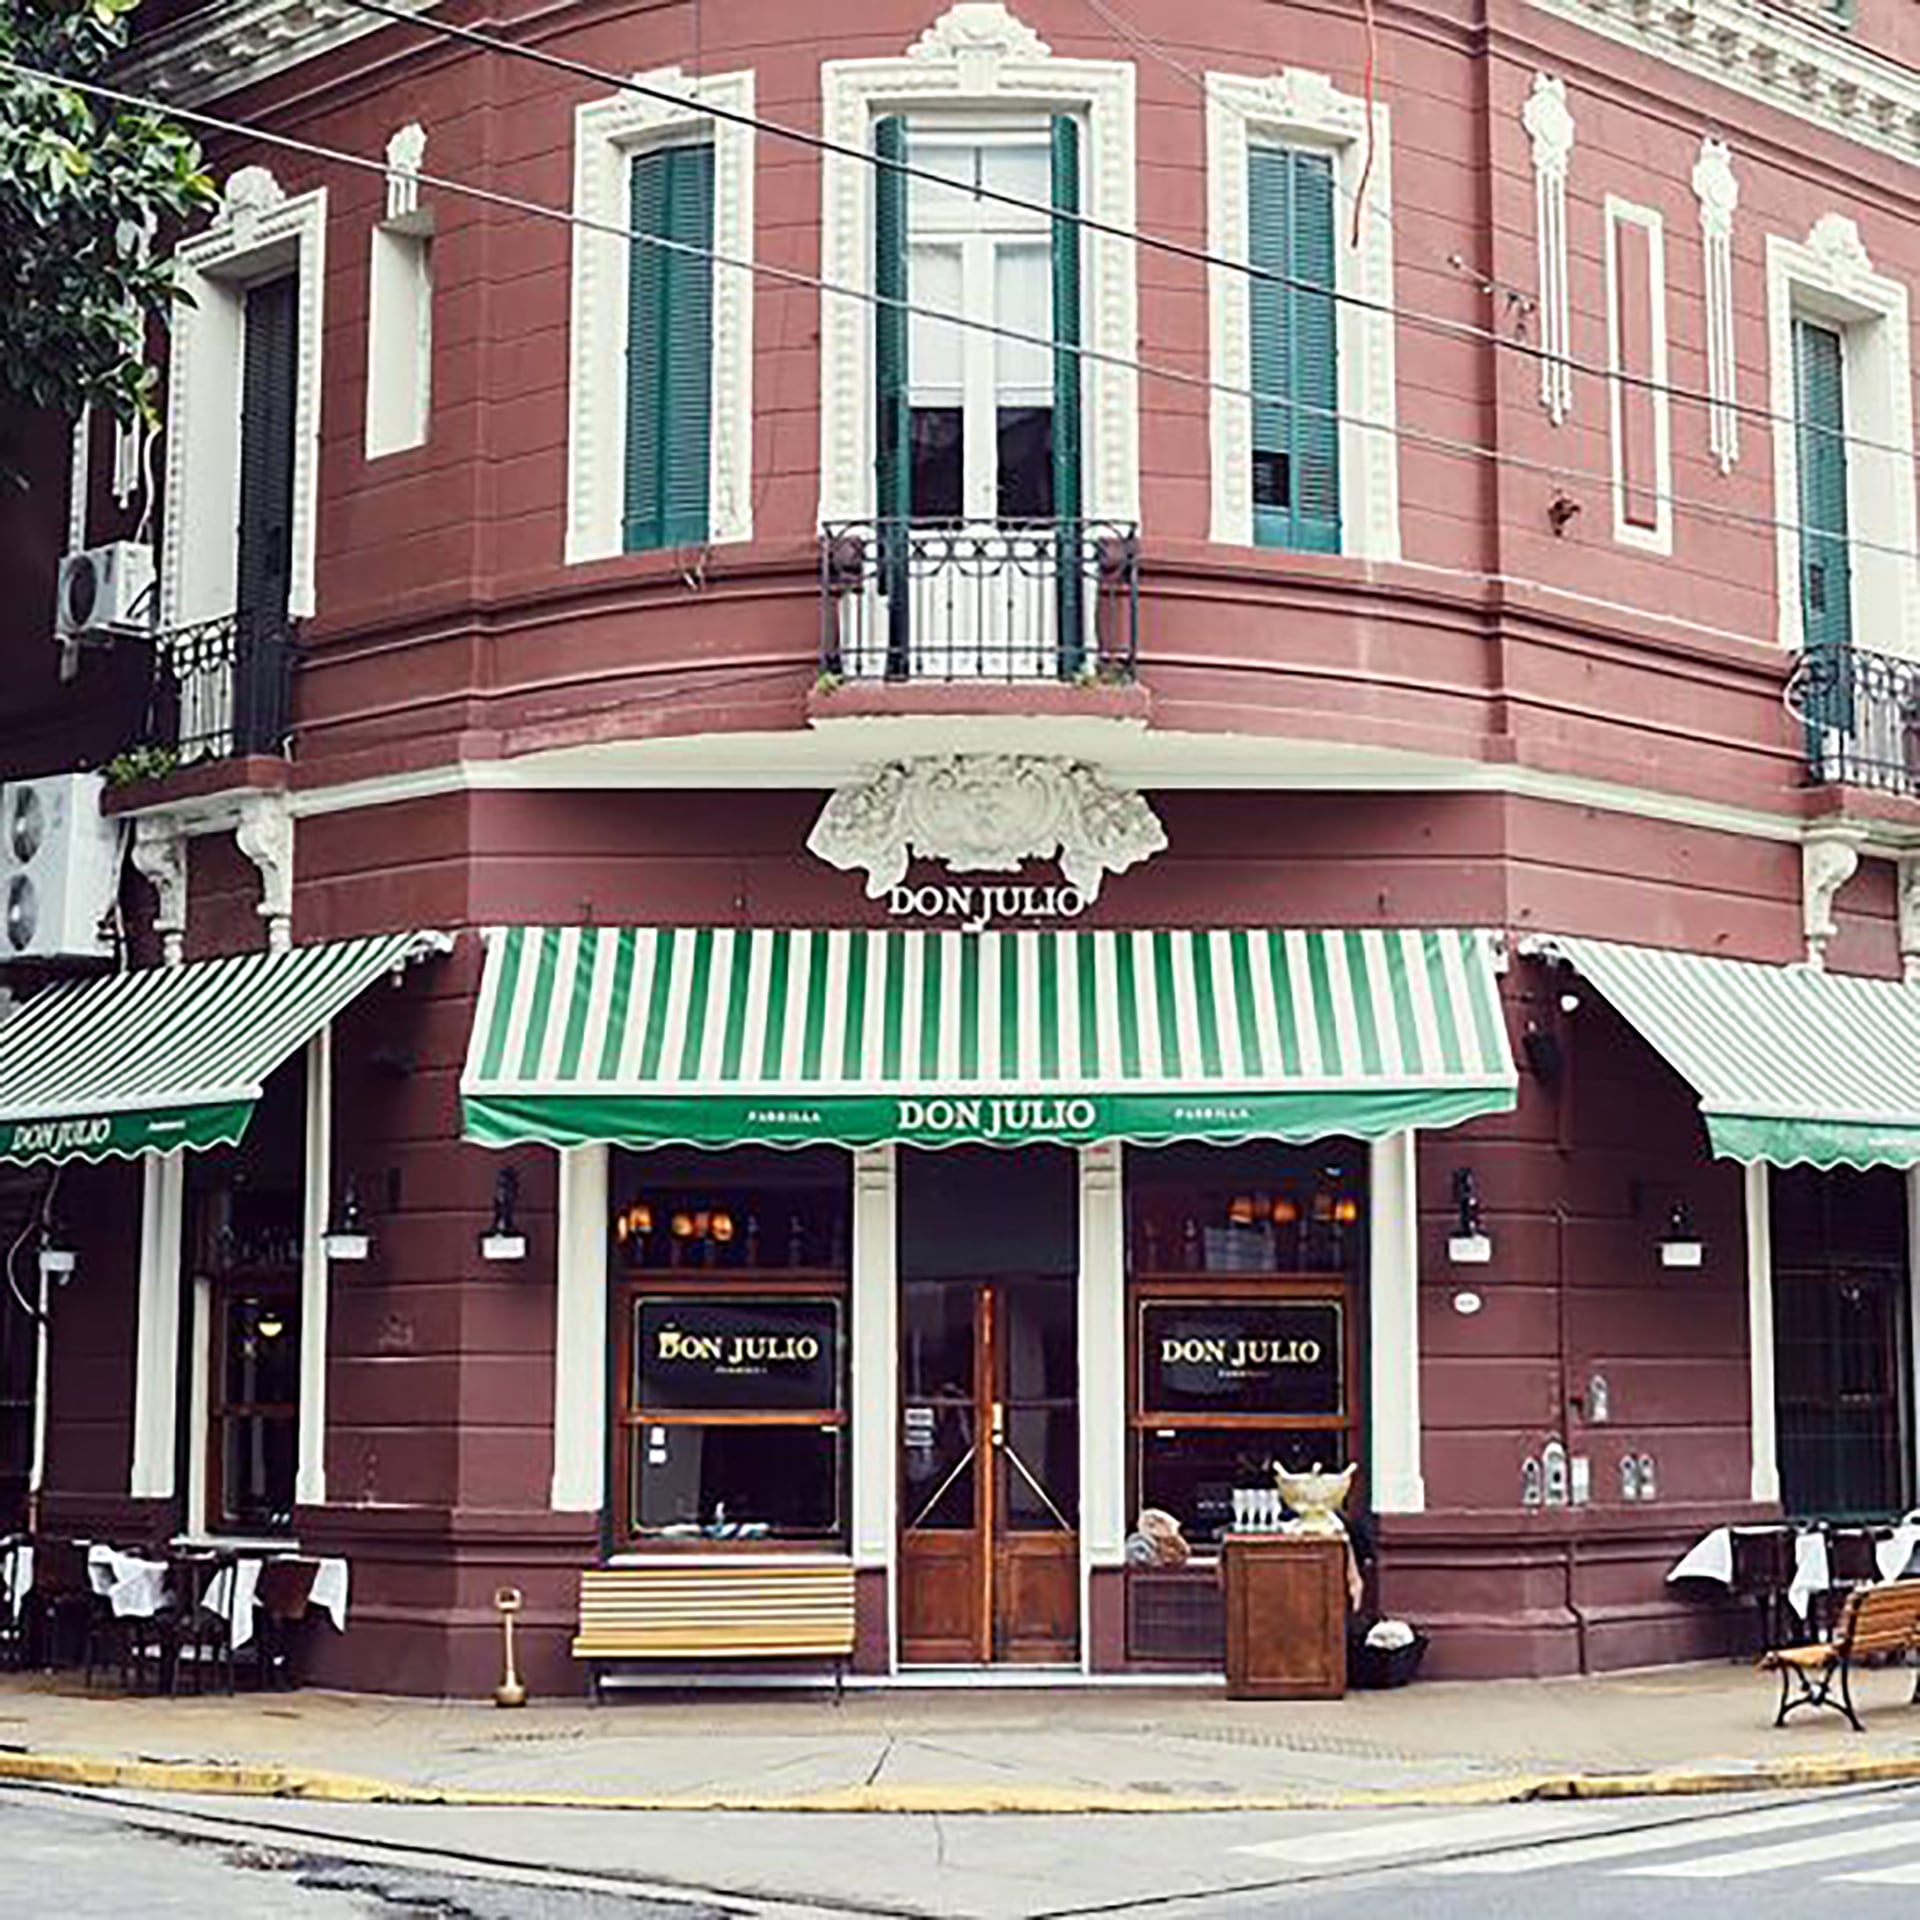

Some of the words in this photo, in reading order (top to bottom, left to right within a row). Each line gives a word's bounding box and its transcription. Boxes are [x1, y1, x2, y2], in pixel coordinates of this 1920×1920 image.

[888, 885, 970, 915] DON
[972, 885, 1084, 930] JULIO
[11, 1122, 57, 1151] DON
[51, 1117, 111, 1153] JULIO
[898, 1101, 980, 1130] DON
[983, 1100, 1095, 1137] JULIO
[658, 1333, 723, 1359] DON
[728, 1336, 819, 1363] JULIO
[1162, 1340, 1226, 1362] DON
[1231, 1340, 1321, 1366] JULIO
